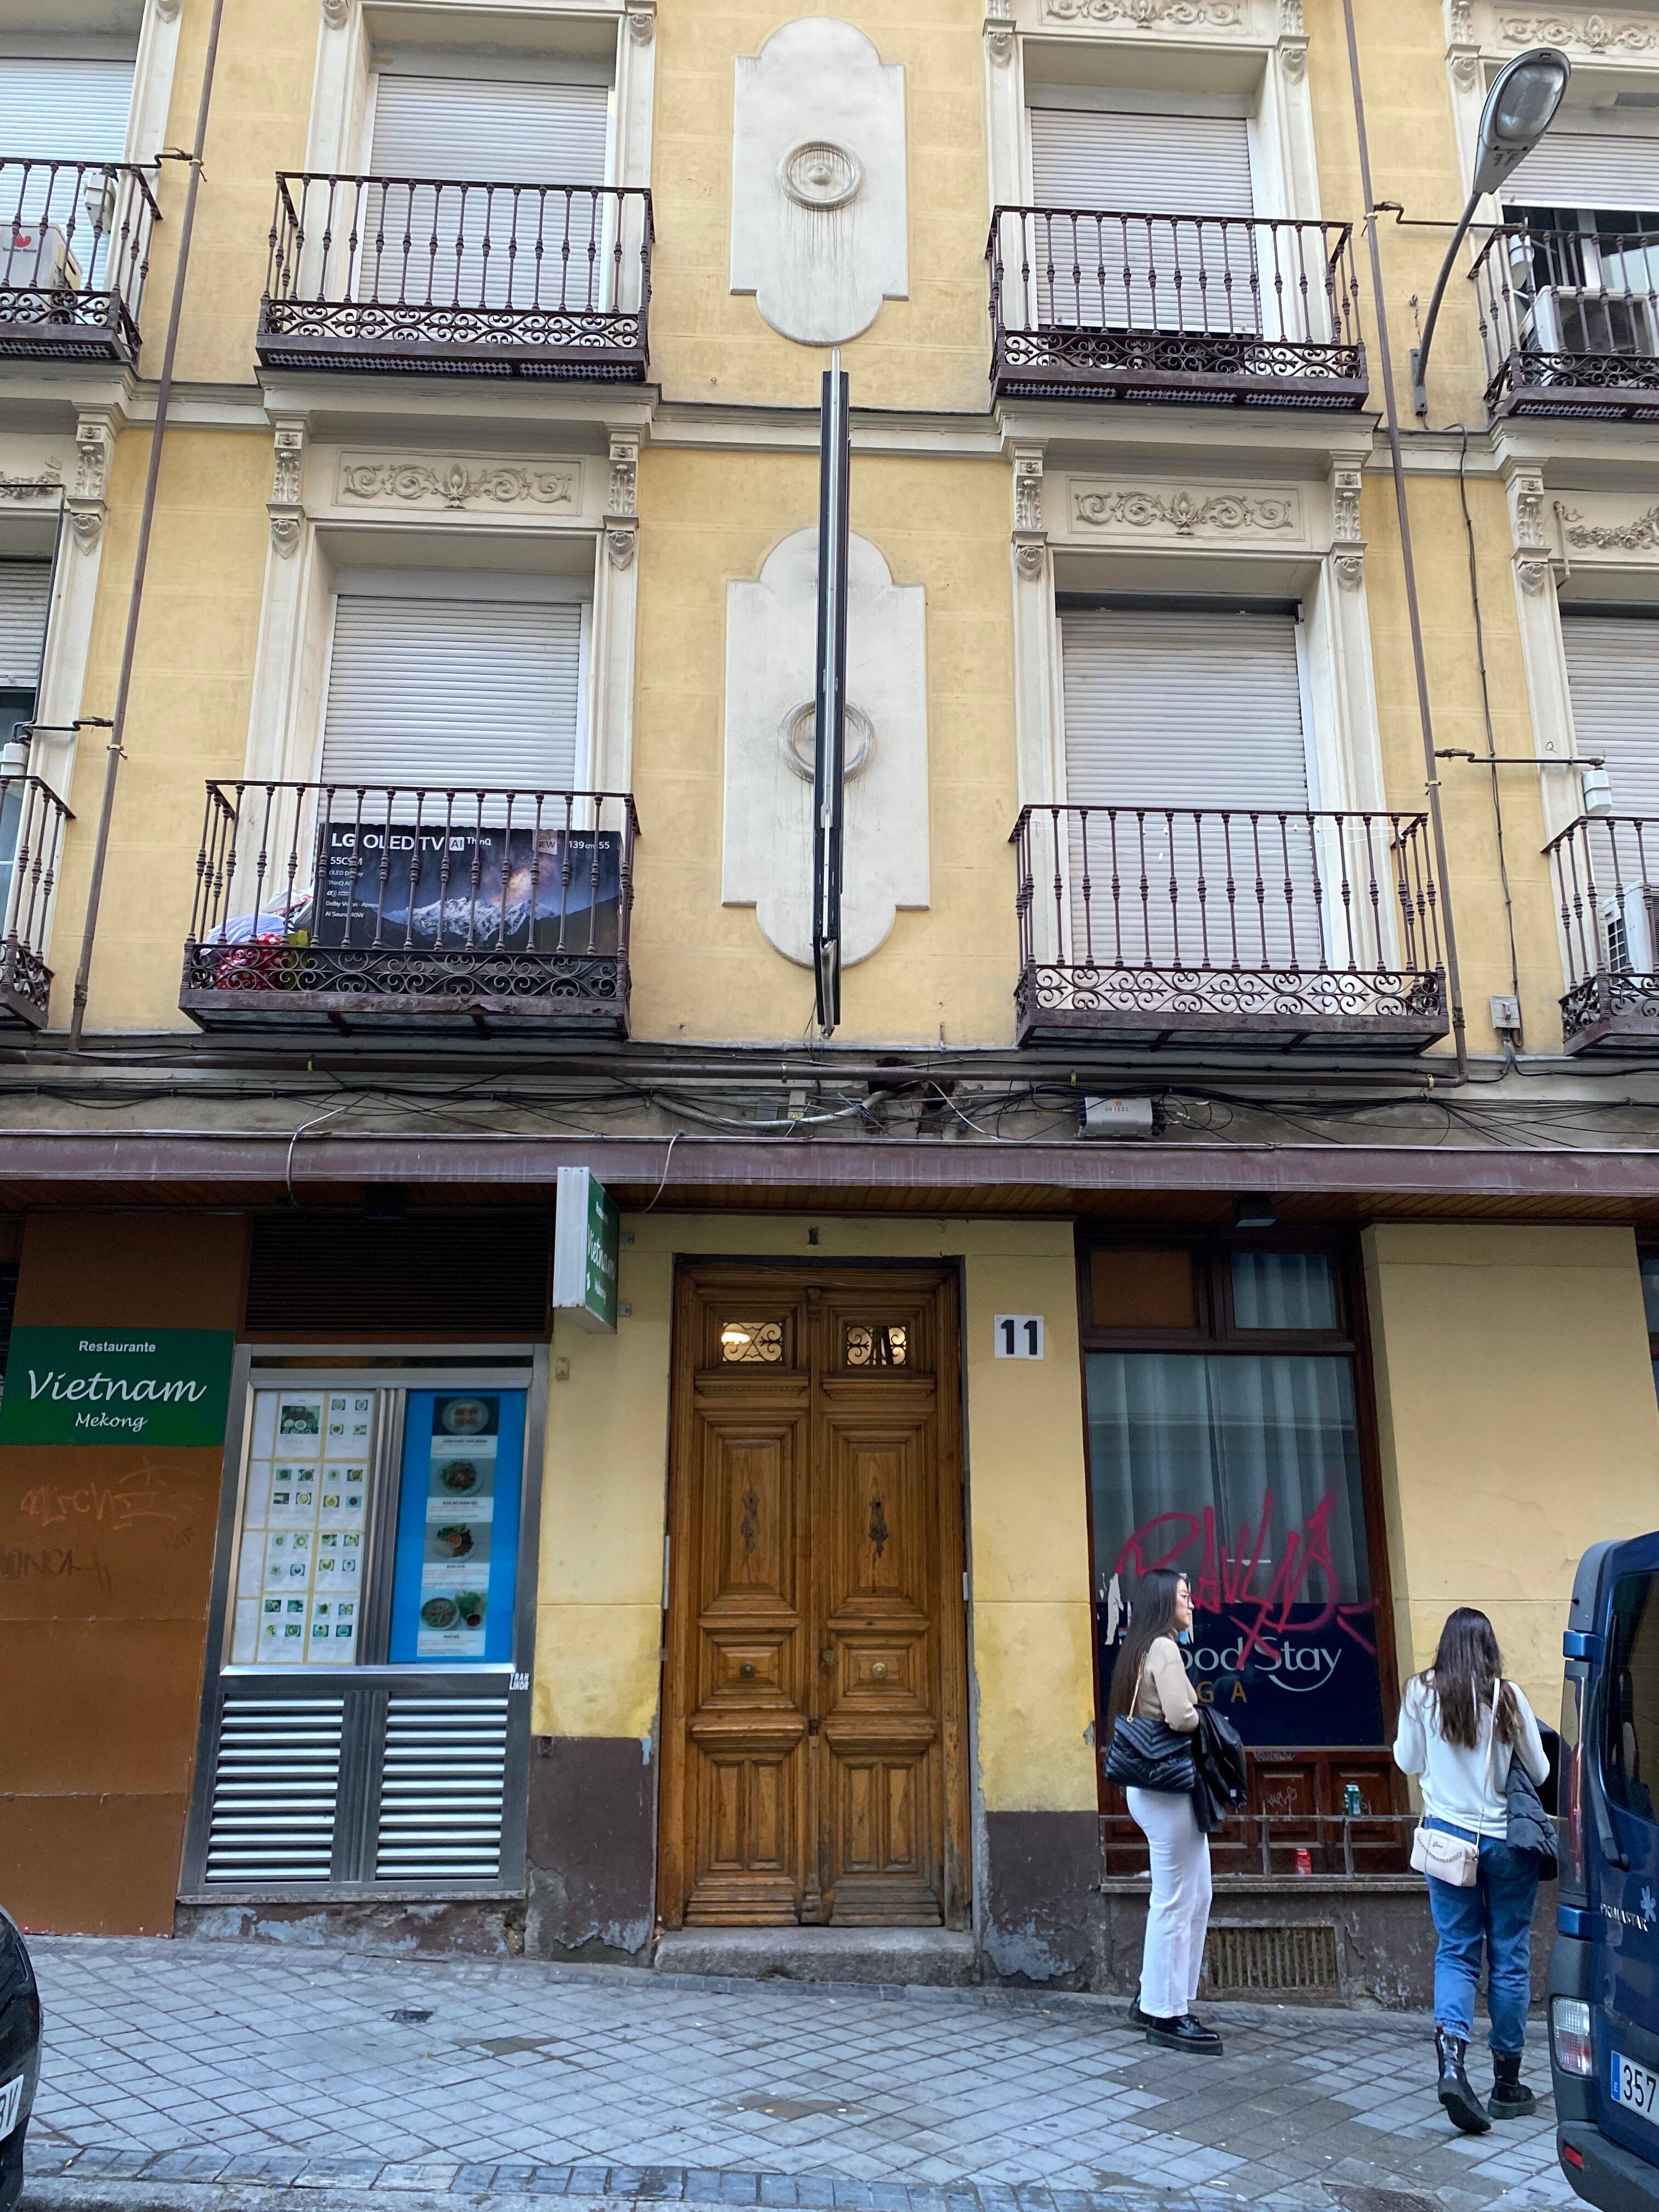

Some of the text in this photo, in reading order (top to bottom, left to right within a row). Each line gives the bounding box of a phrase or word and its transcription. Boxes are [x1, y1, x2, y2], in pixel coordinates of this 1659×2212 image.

[331, 833, 356, 848] LG
[363, 834, 415, 850] OLED
[419, 837, 445, 851] TV
[466, 837, 492, 846] ThnQ
[569, 840, 584, 849] 139
[599, 841, 610, 849] 55
[79, 1340, 156, 1352] Restaurante
[1000, 1319, 1037, 1356] 11
[75, 1412, 148, 1432] Mekong
